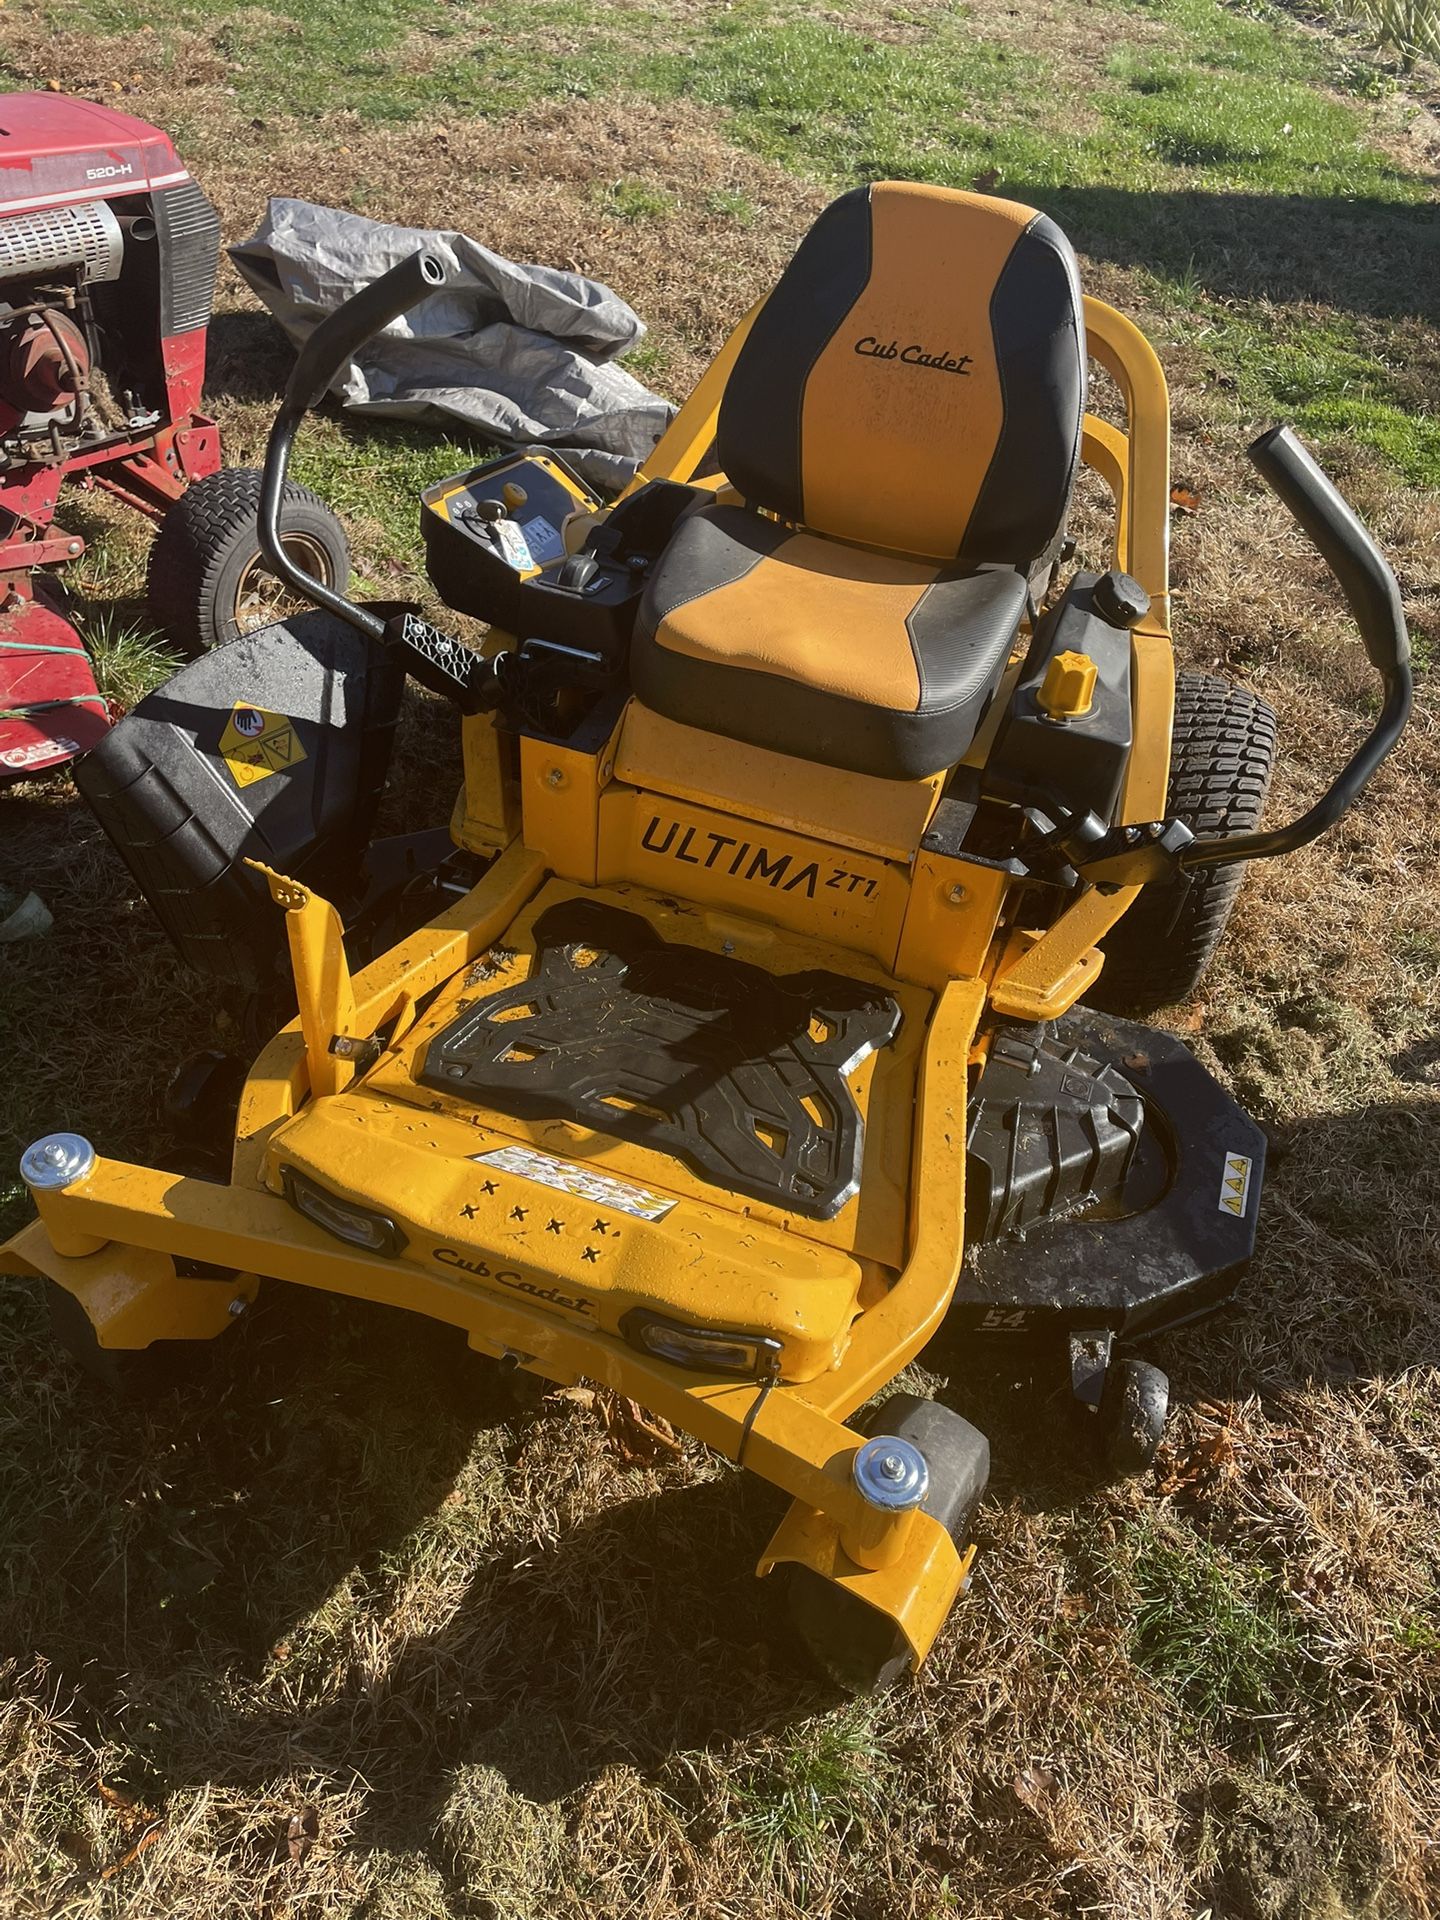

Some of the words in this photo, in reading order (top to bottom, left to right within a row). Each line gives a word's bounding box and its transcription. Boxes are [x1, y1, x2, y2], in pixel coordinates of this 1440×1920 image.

[86, 163, 133, 180] 520-H
[854, 336, 898, 360] Cub
[900, 345, 974, 376] Cadet
[641, 816, 820, 899] ULTIMA
[825, 869, 878, 898] ZT1
[432, 1248, 491, 1278] Cub
[495, 1271, 596, 1316] Cadet
